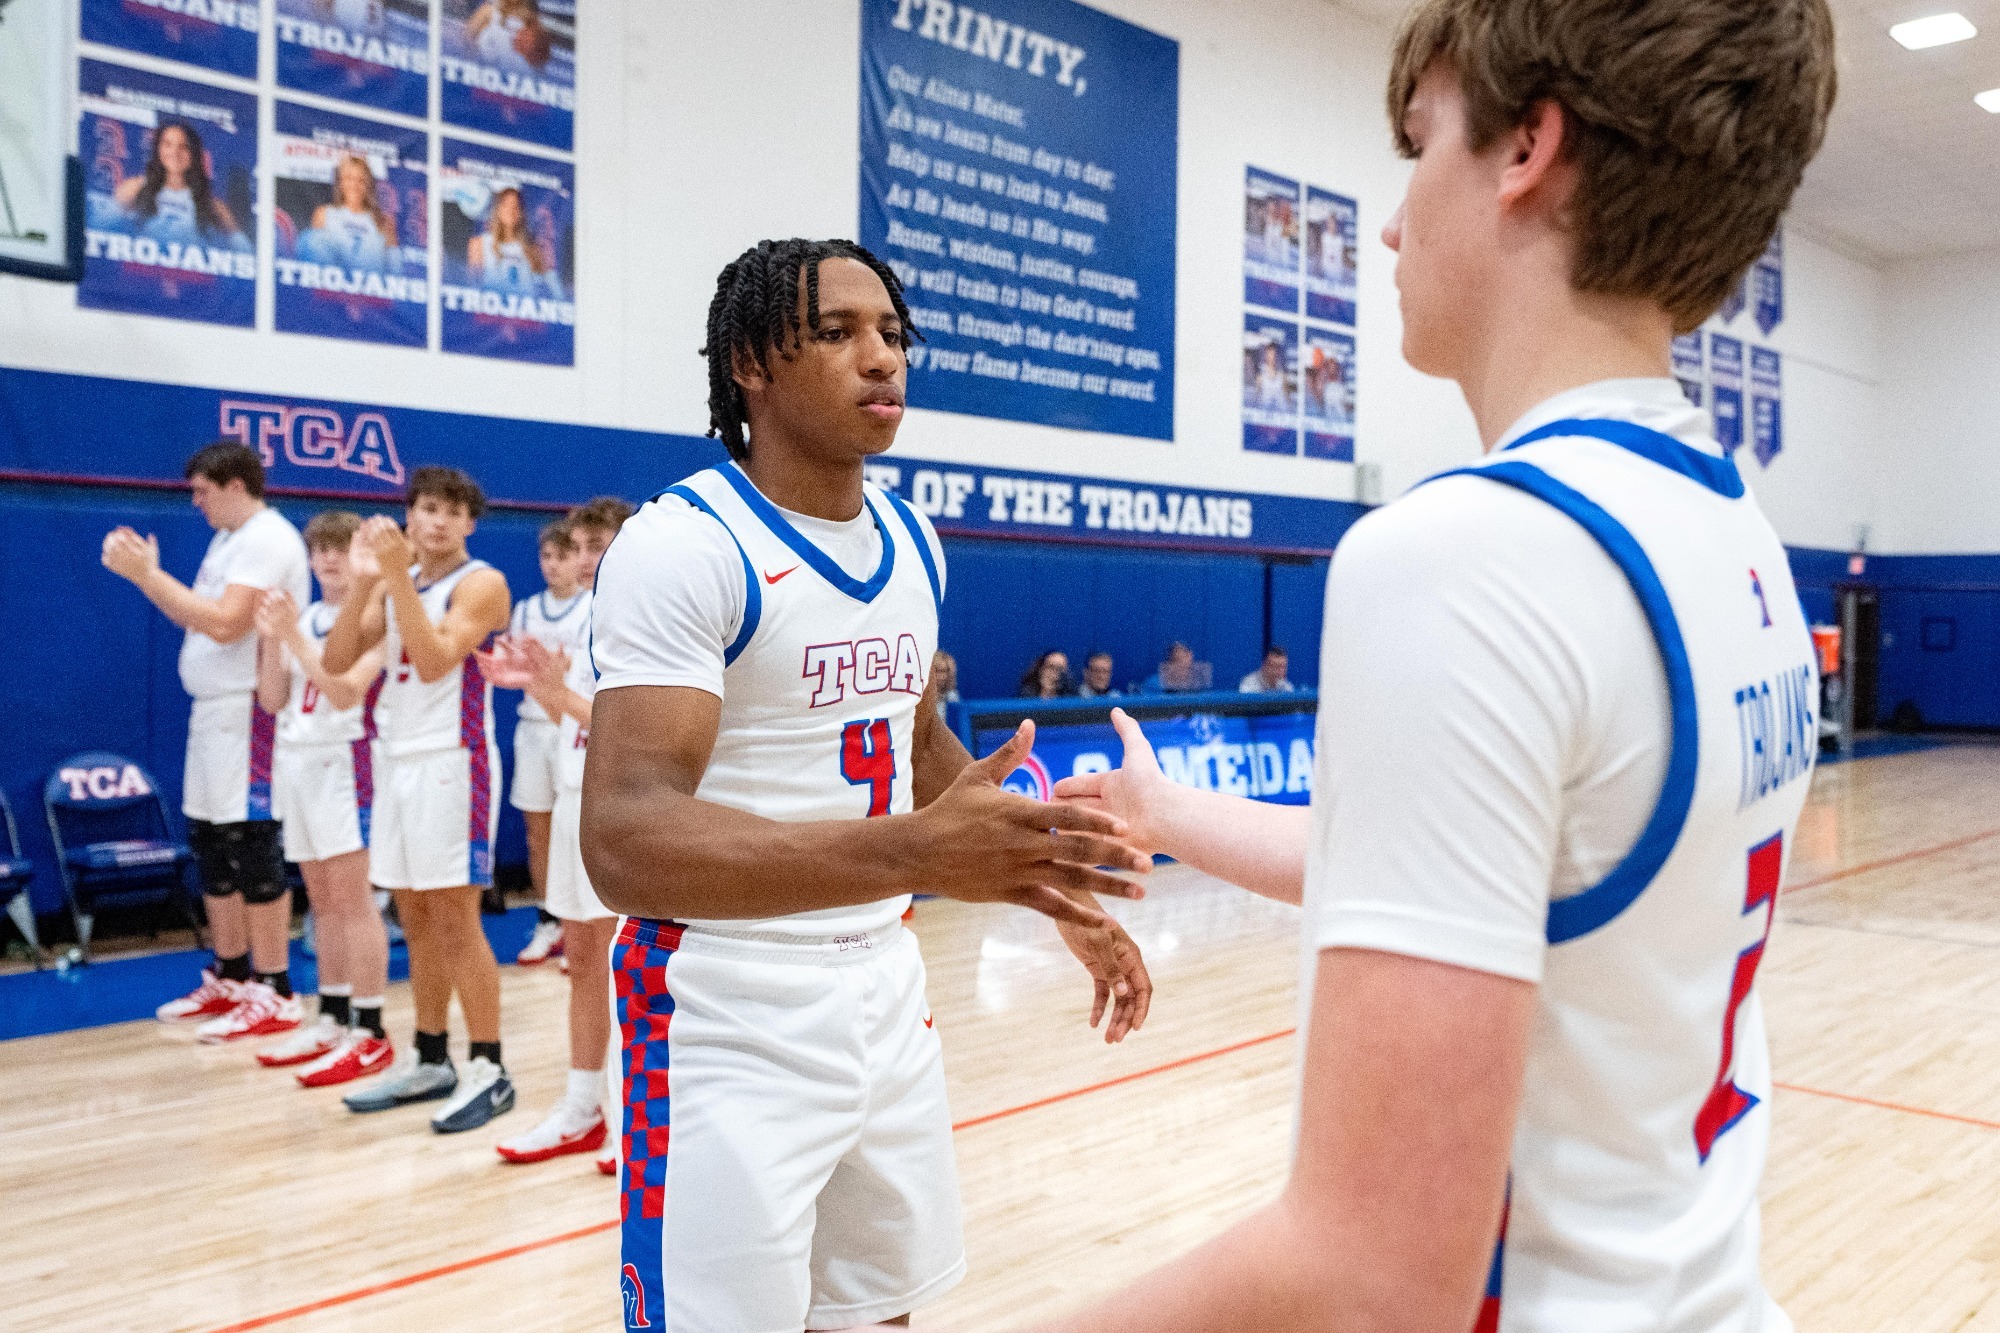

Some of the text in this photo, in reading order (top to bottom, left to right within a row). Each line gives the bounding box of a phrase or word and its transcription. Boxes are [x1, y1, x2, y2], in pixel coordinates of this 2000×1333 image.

[276, 14, 428, 75] TROJANS
[892, 0, 1088, 97] TRINITY,
[441, 55, 575, 110] TROJANS
[924, 77, 972, 111] Alma
[886, 103, 914, 132] As
[915, 115, 942, 141] we
[944, 121, 989, 154] learn
[991, 134, 1032, 166] from
[1032, 146, 1063, 178] day
[1063, 157, 1081, 180] to
[886, 142, 931, 178] Help
[932, 159, 955, 181] us
[980, 171, 1005, 194] we
[1006, 173, 1043, 206] look
[1043, 187, 1063, 209] to
[885, 182, 912, 209] As
[913, 188, 939, 216] He
[941, 194, 989, 228] leads
[990, 209, 1011, 232] us
[1012, 213, 1031, 238] in
[1032, 216, 1059, 244] His
[86, 229, 255, 280] TROJANS
[275, 257, 428, 303] TROJANS
[441, 285, 575, 326] TROJANS
[920, 269, 956, 295] will
[957, 275, 998, 304] train
[1000, 286, 1019, 308] to
[1020, 286, 1051, 314] live
[1053, 293, 1095, 324] God's
[957, 312, 1025, 346] through
[1025, 325, 1051, 350] the
[929, 348, 972, 372] your
[972, 350, 1019, 381] flame
[1020, 358, 1081, 390] become
[1082, 374, 1108, 393] our
[220, 400, 405, 485] TCA
[912, 469, 975, 518] OF
[982, 475, 1074, 527] THE
[1080, 486, 1253, 539] TROJANS
[802, 633, 924, 709] TCA
[60, 765, 150, 800] TCA
[840, 718, 897, 818] 4
[834, 933, 872, 951] TCA
